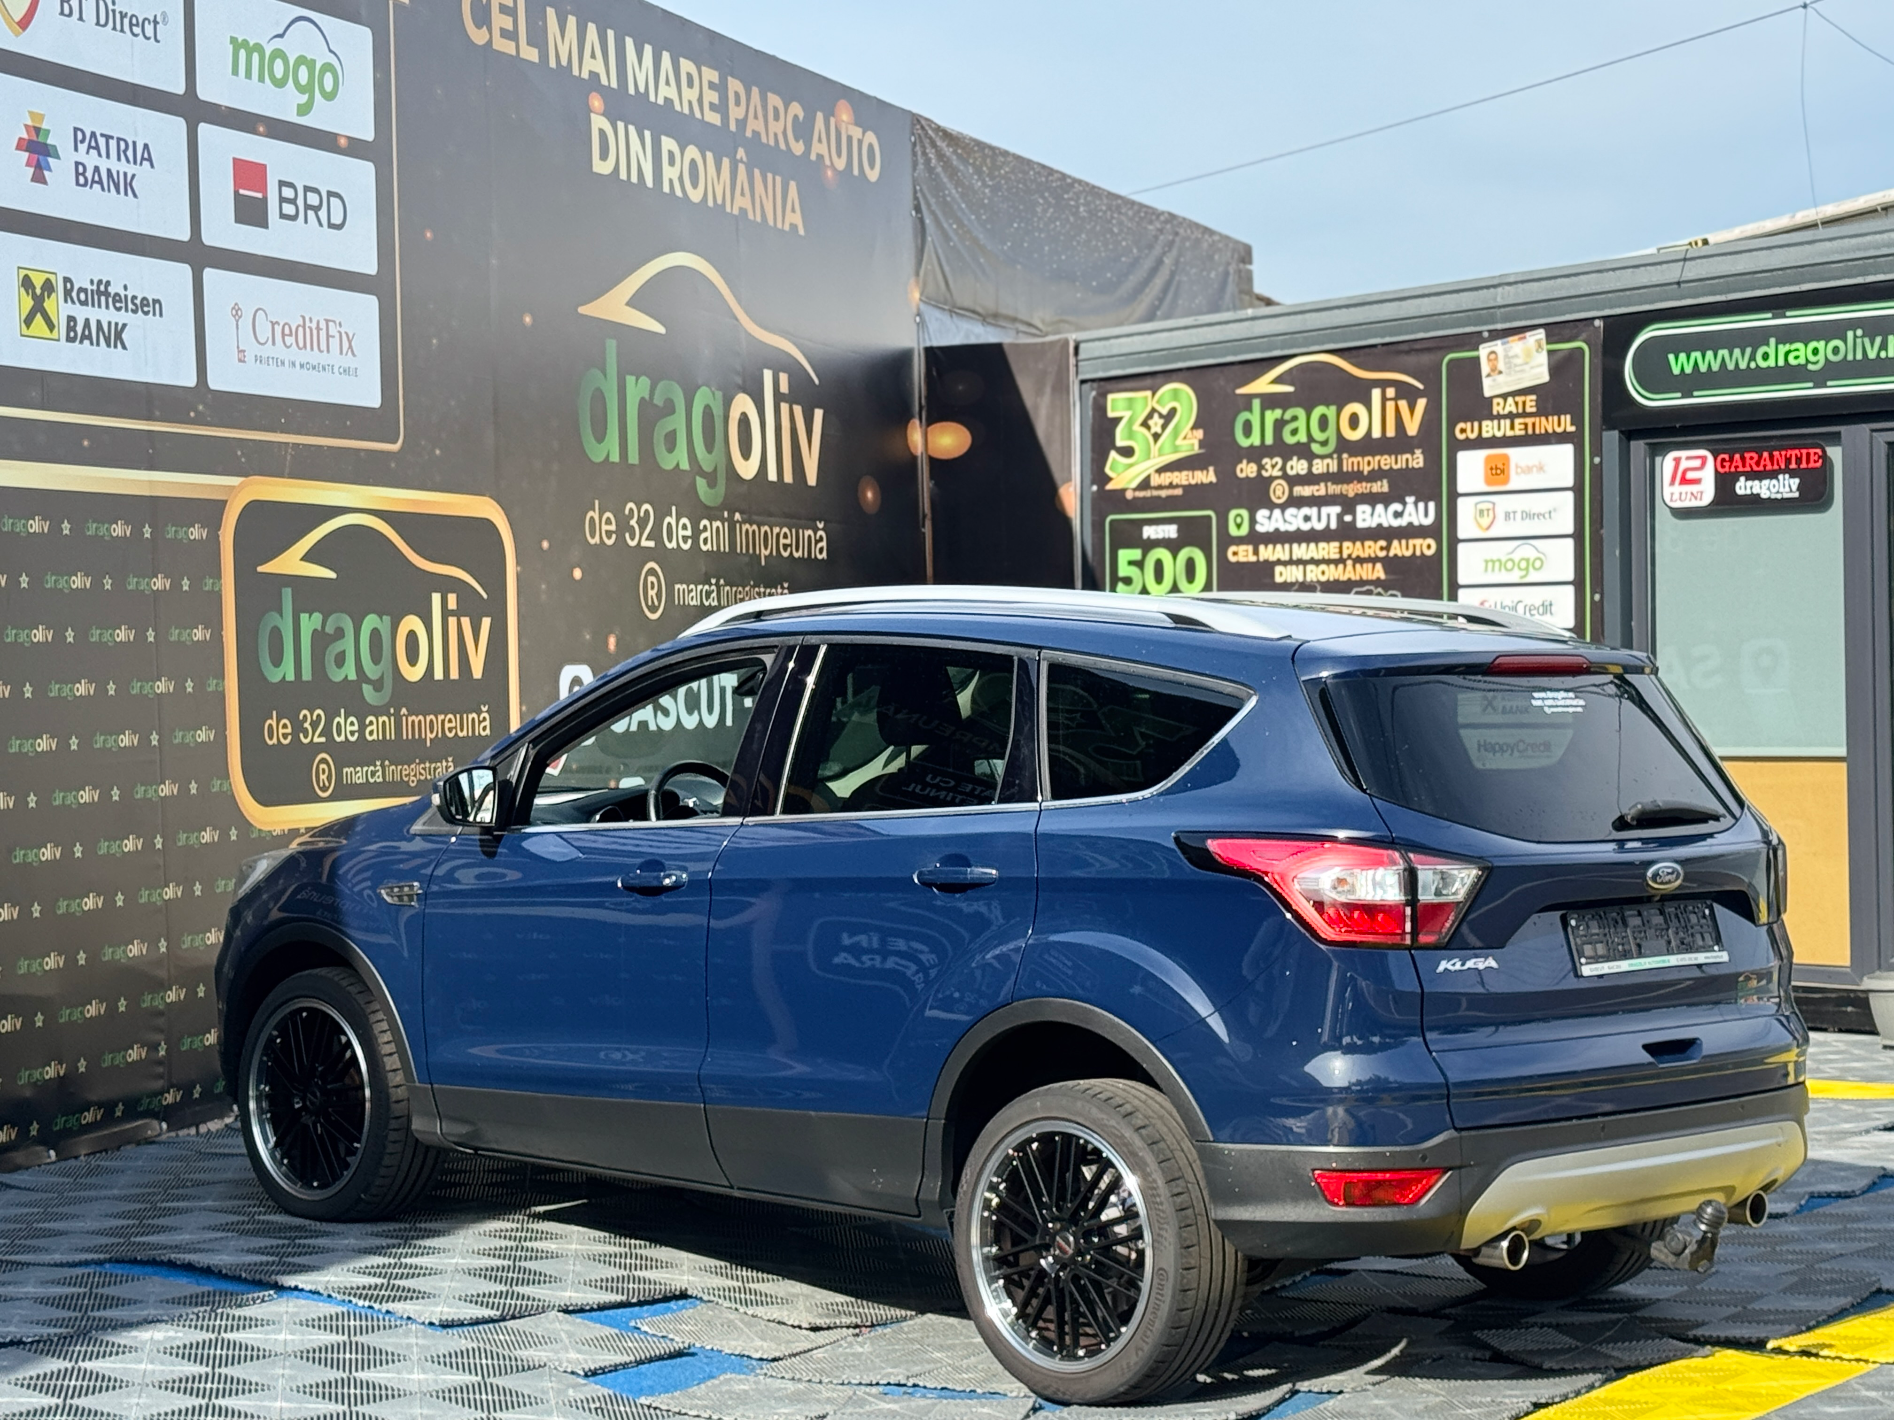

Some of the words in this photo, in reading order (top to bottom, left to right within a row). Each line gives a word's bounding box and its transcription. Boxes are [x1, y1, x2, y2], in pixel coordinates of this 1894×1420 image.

[229, 35, 340, 117] mogo
[461, 0, 539, 63] CEL
[546, 6, 618, 89] MAI
[625, 35, 721, 126] MARE
[727, 75, 805, 157] PARC
[810, 111, 881, 183] AUTO
[72, 126, 155, 170] PATRIA
[73, 160, 138, 199] BANK
[590, 112, 654, 189] DIN
[661, 147, 805, 236] ROMÂNIA
[277, 179, 348, 232] BRD
[62, 276, 164, 318] Raiffeisen
[65, 314, 129, 351] BANK
[251, 307, 357, 358] CreditFix
[254, 354, 286, 368] PRIETEN
[299, 361, 335, 375] MOMENTE
[1492, 394, 1537, 415] RATE
[577, 338, 824, 507] dragoliv
[1104, 382, 1200, 480] 32
[1234, 387, 1428, 455] dragoliv
[1454, 421, 1479, 440] CU
[1481, 414, 1576, 438] BULETINUL
[1236, 459, 1258, 478] de
[1261, 456, 1283, 477] 32
[1286, 455, 1309, 476] de
[1311, 453, 1338, 474] ani
[1341, 448, 1424, 475] împreună
[1489, 463, 1506, 476] tbi
[1514, 462, 1546, 476] bank
[1669, 455, 1708, 487] 12
[1715, 448, 1823, 473] GARANTIE
[1292, 481, 1326, 497] marcă
[1327, 478, 1389, 498] înregistrată
[1669, 490, 1705, 503] LUNI
[1735, 473, 1800, 499] dragoliv
[1255, 505, 1342, 533] SASCUT
[1355, 496, 1436, 529] BACĂU
[1478, 508, 1491, 518] BT
[1504, 511, 1518, 522] BT
[1, 515, 50, 536] dragoliv
[85, 519, 132, 540] dragoliv
[165, 522, 208, 543] dragoliv
[584, 500, 617, 546] de
[624, 502, 655, 548] 32
[662, 505, 692, 550] de
[700, 511, 729, 553] ani
[734, 512, 828, 566] împreună
[1142, 524, 1178, 540] PESTE
[1226, 545, 1258, 563] CEL
[1258, 543, 1290, 562] MAI
[1292, 541, 1340, 560] MARE
[1342, 540, 1387, 559] PARC
[1389, 538, 1437, 557] AUTO
[44, 571, 92, 593] dragoliv
[126, 573, 171, 594] dragoliv
[1116, 546, 1207, 597] 500
[1274, 565, 1304, 583] DIN
[1305, 559, 1386, 582] ROMÂNIA
[1483, 556, 1544, 580] mogo
[674, 577, 718, 607] marcă
[5, 624, 54, 646] dragoliv
[89, 625, 136, 646] dragoliv
[168, 625, 212, 645] dragoliv
[257, 587, 492, 706] dragoliv
[48, 678, 96, 700] dragoliv
[130, 677, 175, 698] dragoliv
[611, 674, 738, 733] ASCUT
[264, 710, 292, 745] de
[299, 708, 326, 744] 32
[332, 708, 359, 742] de
[365, 710, 395, 740] ani
[400, 704, 491, 747] împreună
[8, 734, 58, 756] dragoliv
[93, 730, 139, 752] dragoliv
[172, 726, 215, 746] dragoliv
[1476, 738, 1551, 757] HappyCredit
[343, 758, 383, 785] marcă
[52, 785, 100, 809] dragoliv
[134, 780, 179, 800] dragoliv
[12, 842, 62, 866] dragoliv
[97, 834, 144, 857] dragoliv
[176, 826, 220, 848] dragoliv
[1656, 868, 1678, 883] Ford
[55, 892, 104, 916] dragoliv
[138, 882, 183, 906] dragoliv
[17, 951, 65, 976] dragoliv
[102, 939, 148, 963] dragoliv
[181, 927, 224, 950] dragoliv
[1435, 956, 1499, 974] KUGA
[58, 999, 106, 1024] dragoliv
[140, 985, 187, 1009] dragoliv
[17, 1060, 66, 1086] dragoliv
[101, 1044, 148, 1069] dragoliv
[180, 1028, 219, 1051] dragoli
[53, 1105, 104, 1132] dragoliv
[137, 1088, 183, 1113] dragoliv
